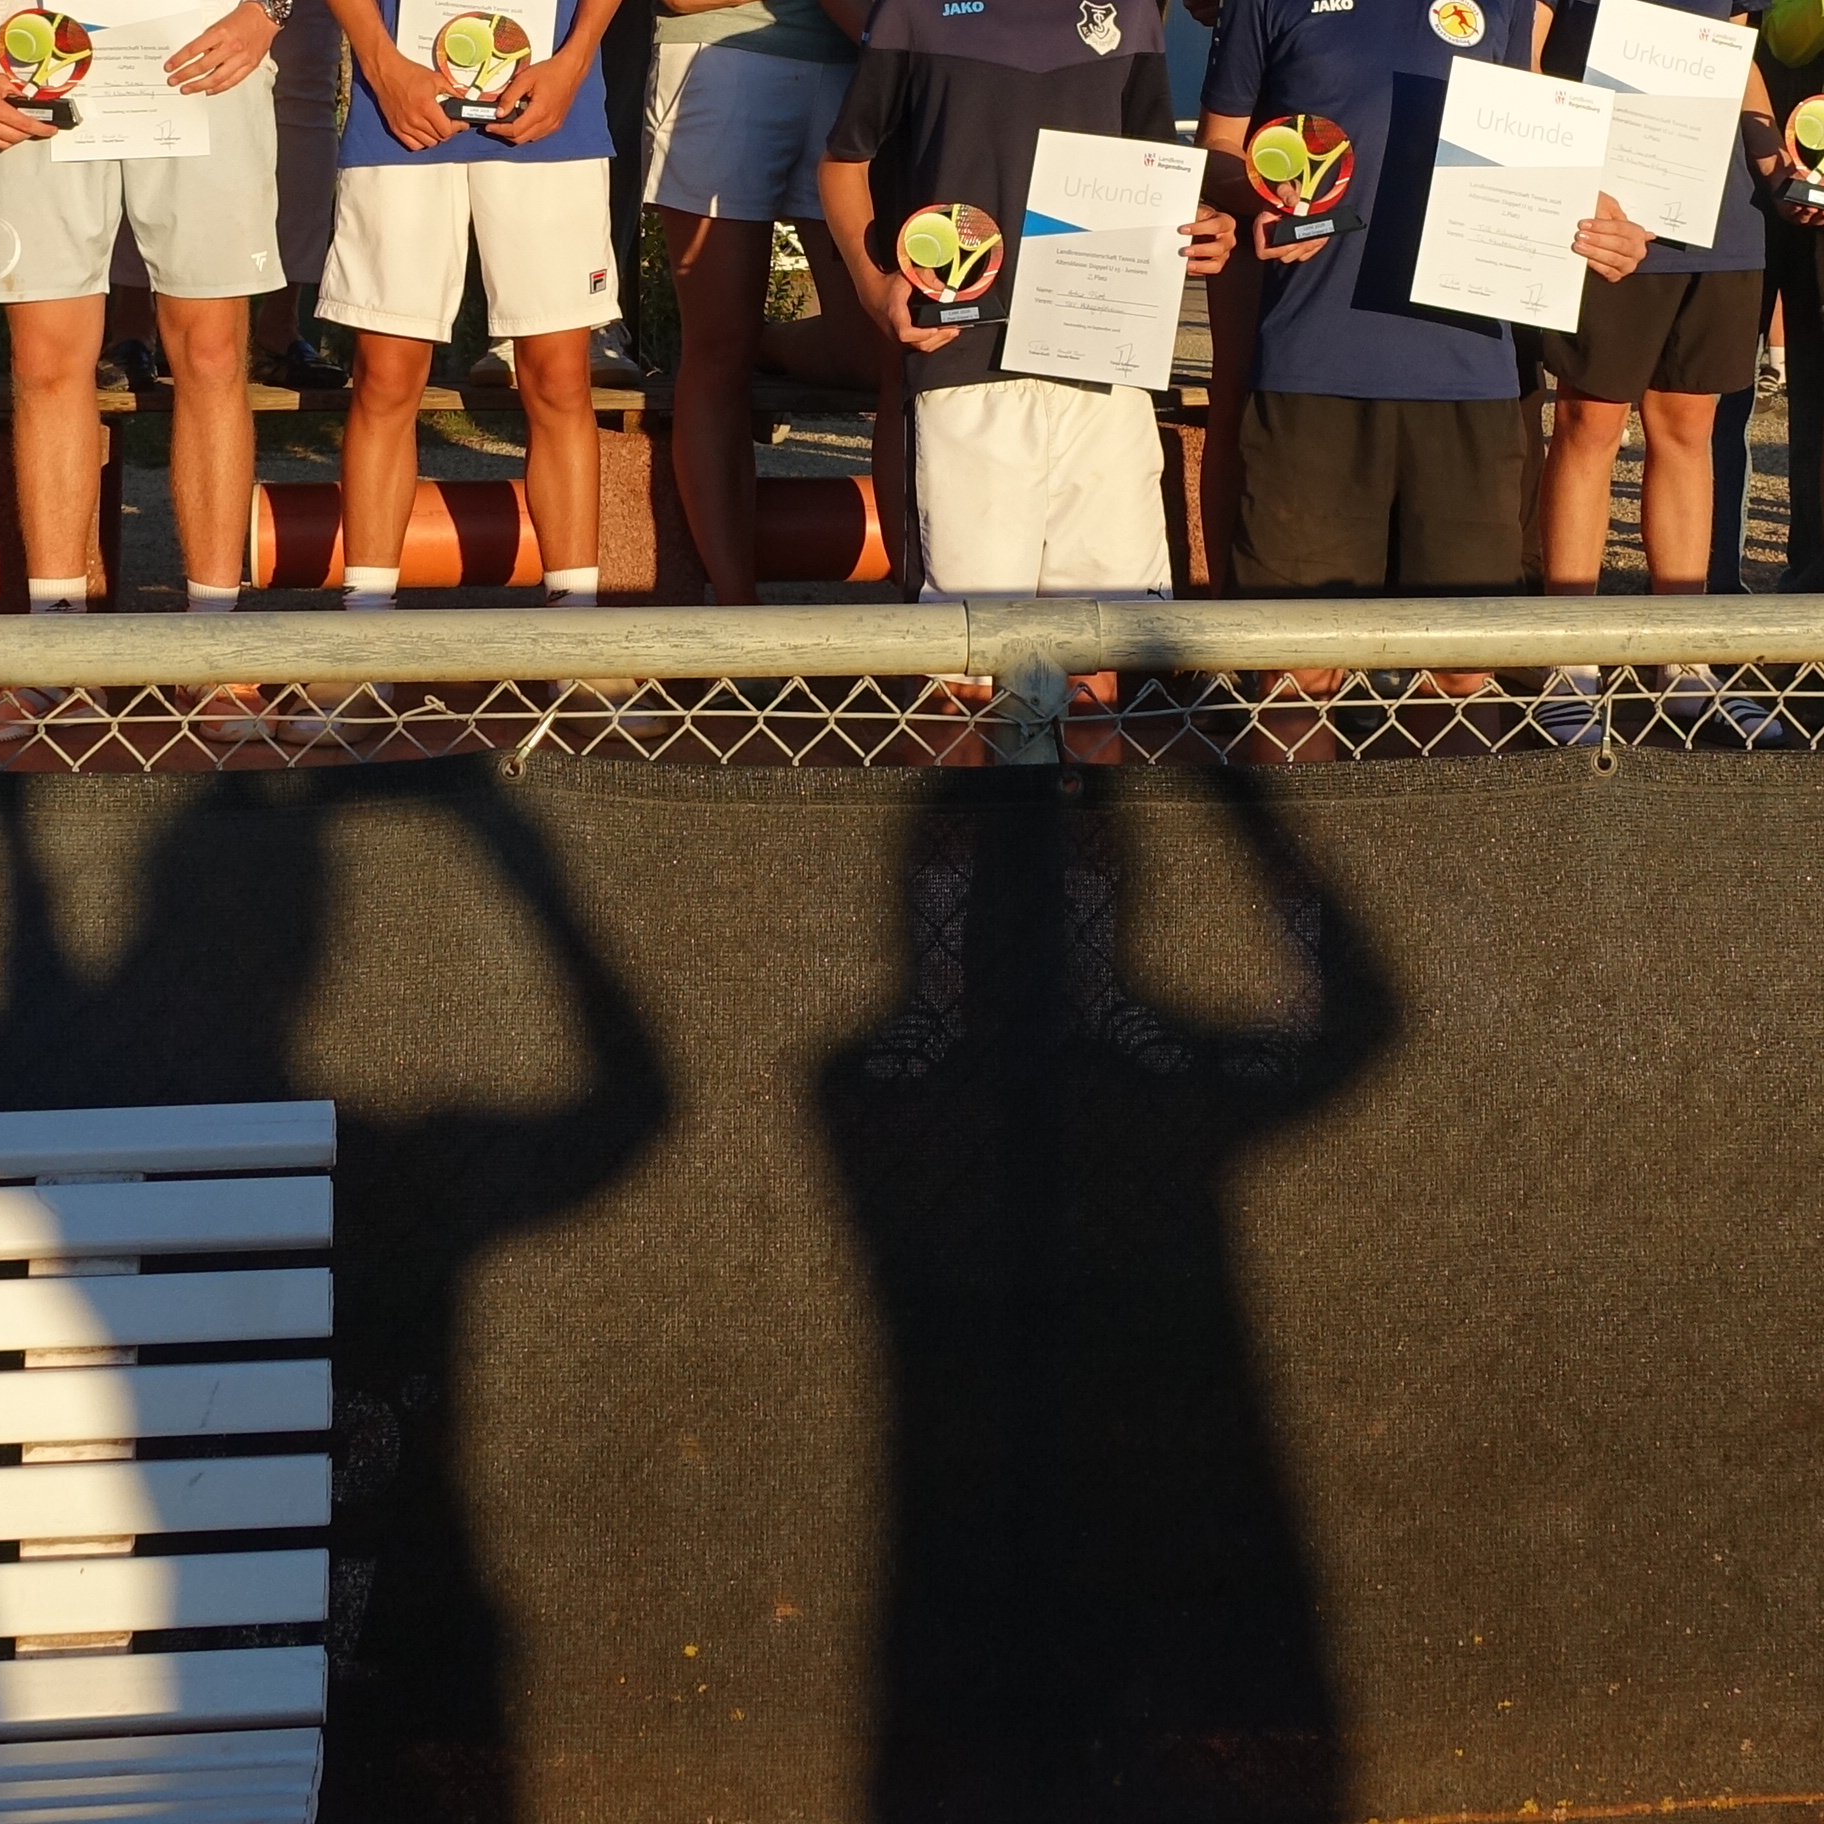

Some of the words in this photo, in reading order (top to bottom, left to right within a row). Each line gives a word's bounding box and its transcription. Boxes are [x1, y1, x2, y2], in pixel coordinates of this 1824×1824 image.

[942, 1, 984, 16] JAKO
[1713, 32, 1738, 42] Landkreis
[1712, 38, 1743, 50] Regensburg
[1622, 40, 1716, 80] Urkunde
[1568, 94, 1594, 104] Landkreis
[1568, 100, 1601, 114] Regensburg
[1477, 107, 1574, 148] Urkunde
[1158, 156, 1184, 165] Landkreis
[1157, 162, 1192, 174] Regensburg
[1064, 176, 1163, 208] Urkunde
[1530, 193, 1547, 202] Tennis
[1500, 198, 1520, 209] Doppel
[1055, 247, 1118, 262] Landkreismeisterschaft
[1117, 255, 1135, 263] Tennis
[1088, 262, 1109, 272] Doppel
[1124, 267, 1148, 276] Junioren
